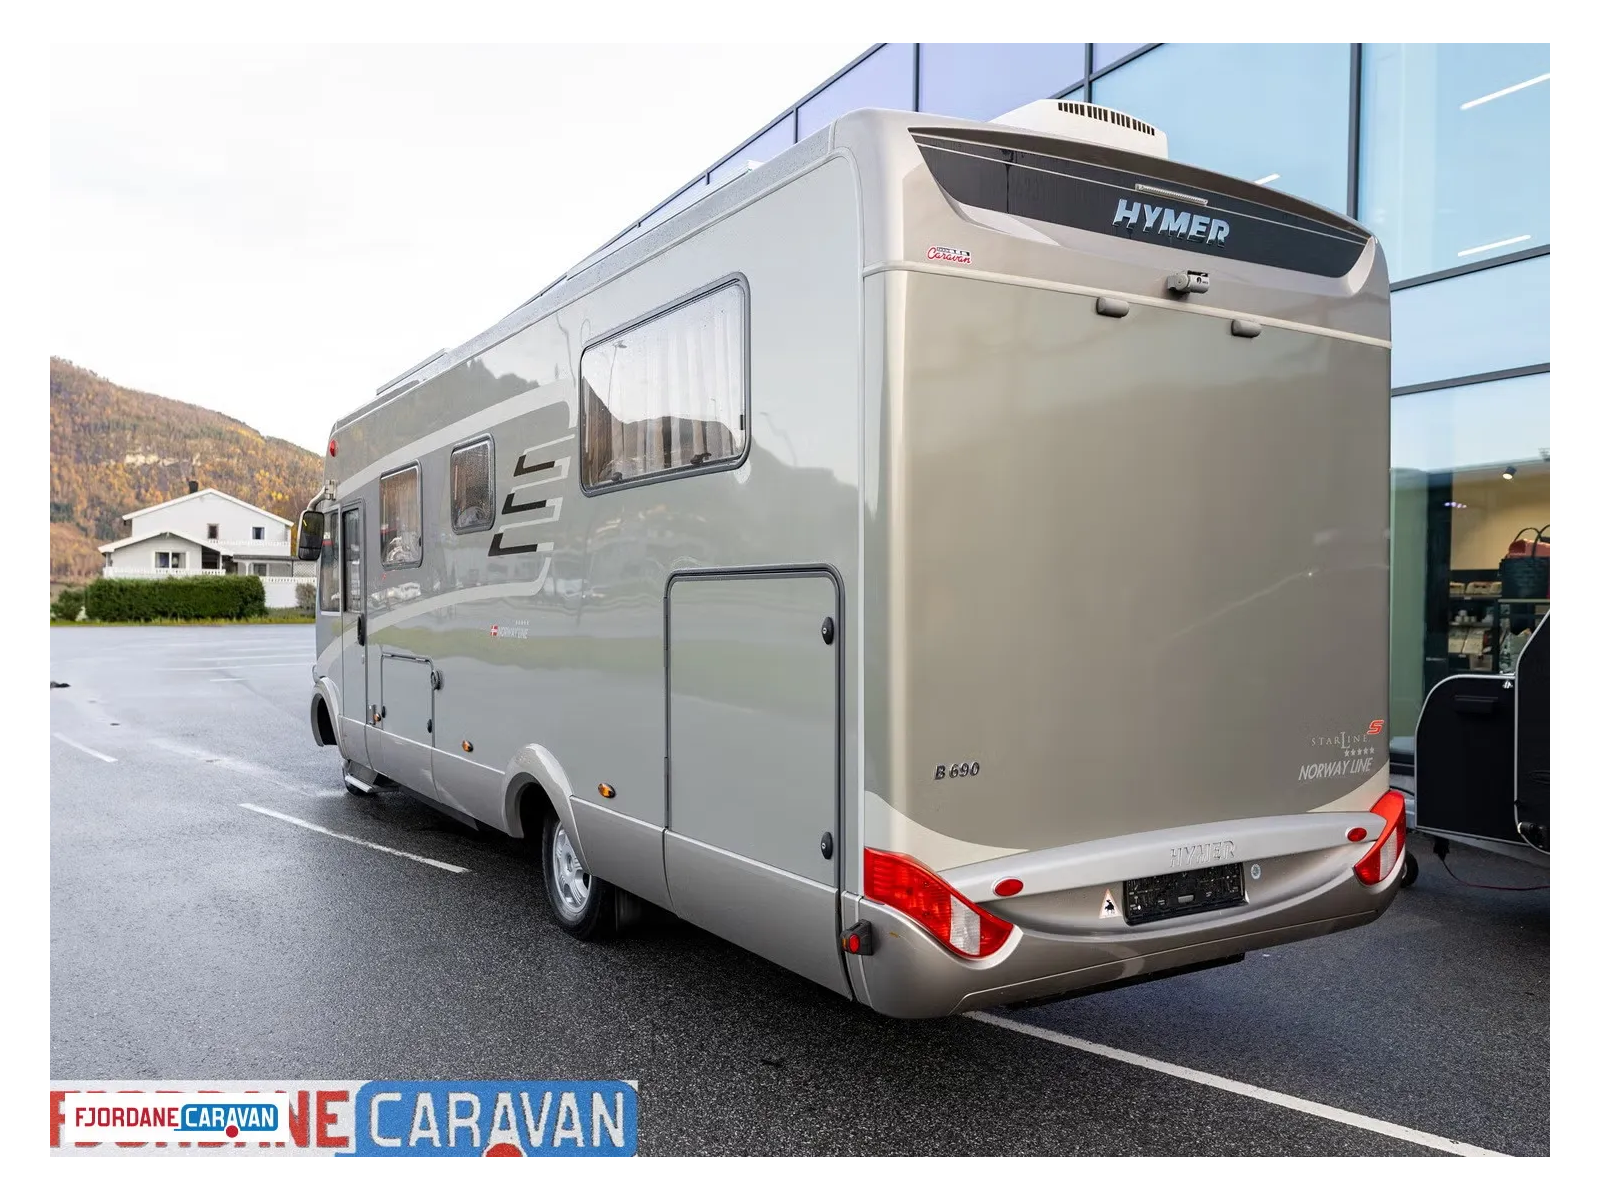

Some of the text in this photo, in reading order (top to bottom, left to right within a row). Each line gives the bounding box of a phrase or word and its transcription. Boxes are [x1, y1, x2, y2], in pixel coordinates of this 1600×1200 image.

[1111, 198, 1230, 248] HYMER
[927, 246, 971, 264] Caravan
[1367, 719, 1385, 735] S
[1311, 731, 1368, 749] STARLINE
[934, 761, 980, 780] B 690
[1298, 757, 1374, 781] NORWAY LINE
[1169, 840, 1237, 868] HYMER
